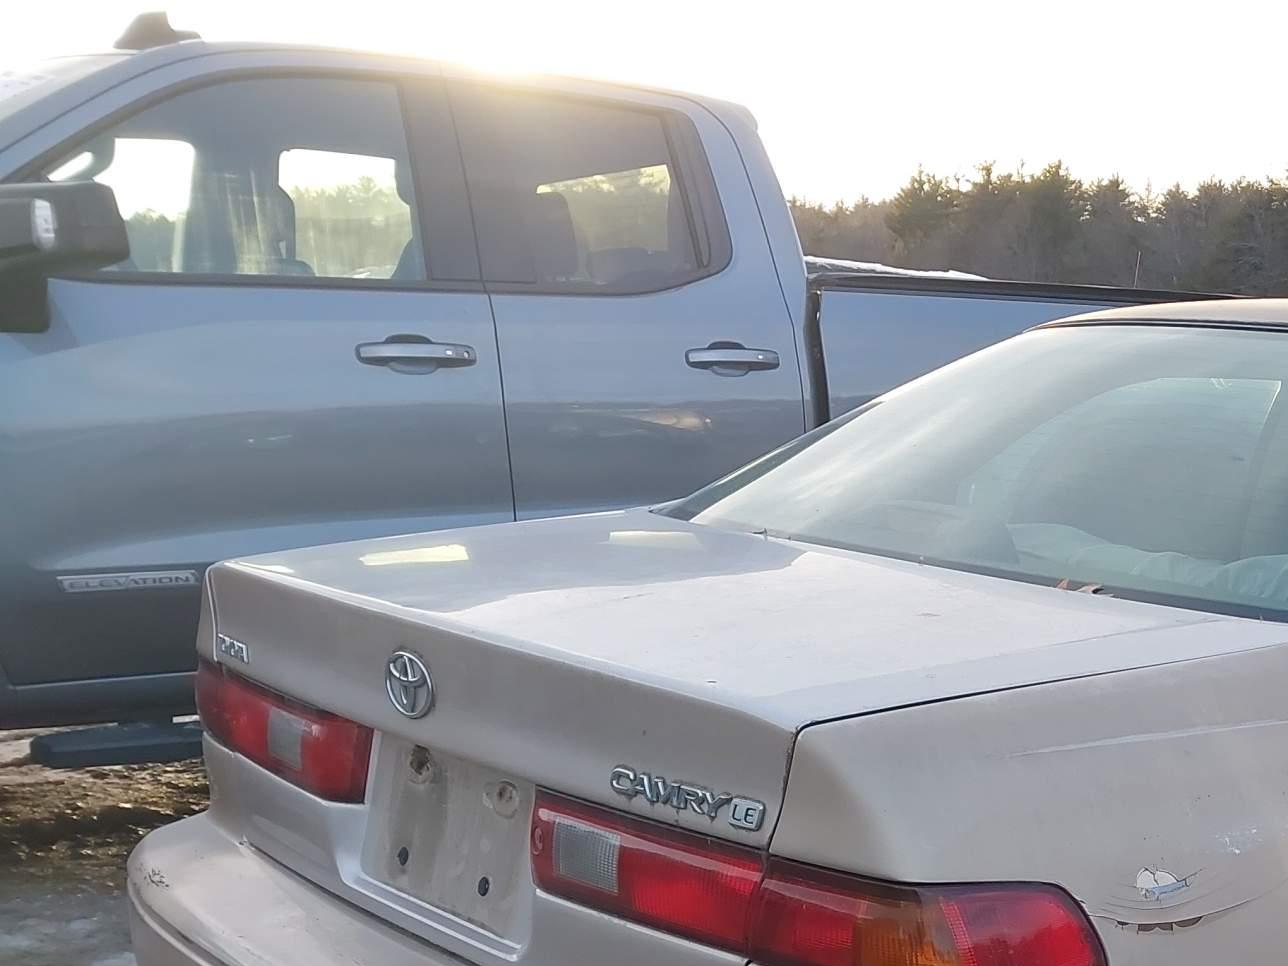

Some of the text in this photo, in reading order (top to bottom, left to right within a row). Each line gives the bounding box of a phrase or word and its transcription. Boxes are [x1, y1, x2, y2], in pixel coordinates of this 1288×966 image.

[68, 575, 191, 589] ELEVATION
[610, 764, 756, 825] CAMRY LE
